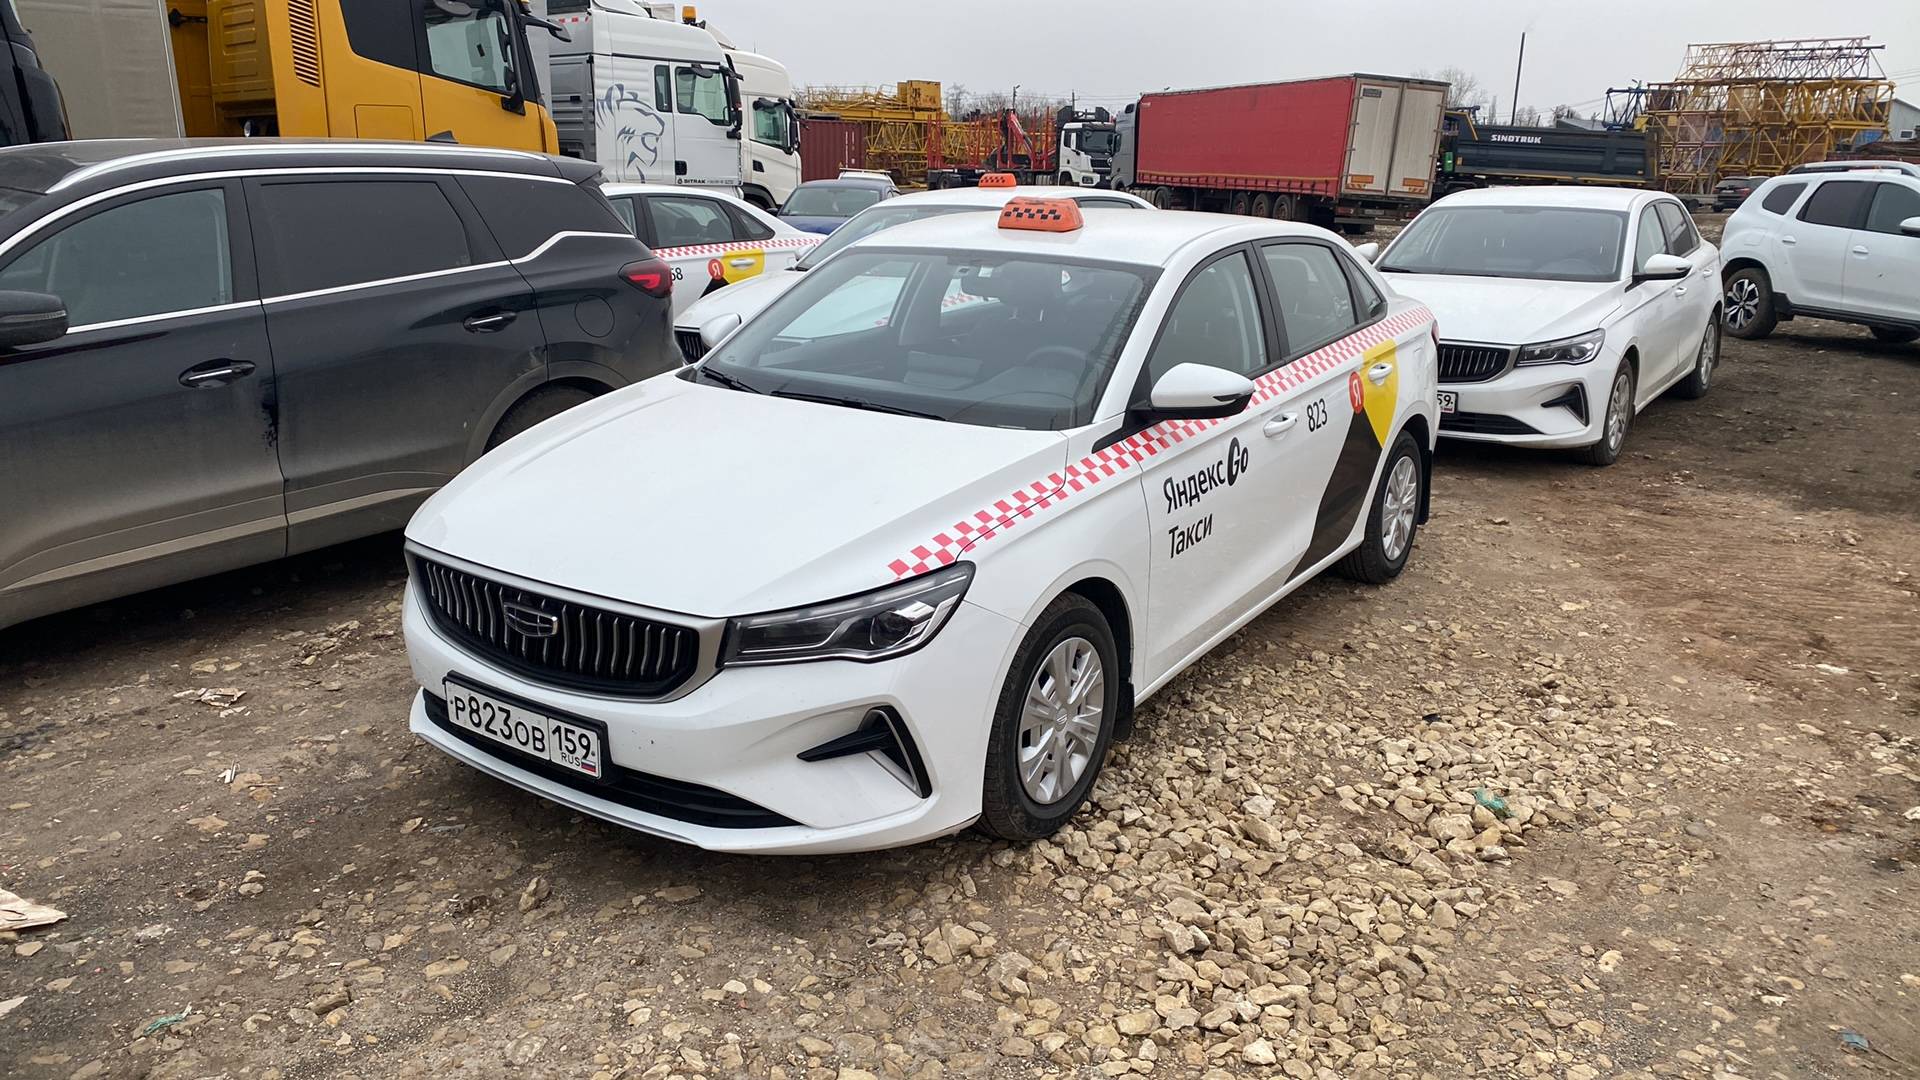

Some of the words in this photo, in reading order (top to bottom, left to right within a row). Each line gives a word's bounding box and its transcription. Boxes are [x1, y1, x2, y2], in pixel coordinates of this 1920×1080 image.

[1490, 134, 1542, 144] SINOTRUK
[1306, 398, 1328, 432] 823
[1163, 459, 1226, 514] Яндекс
[1227, 436, 1249, 487] Go
[1168, 513, 1213, 559] Такси
[551, 724, 592, 760] 159
[561, 751, 582, 767] RUS
